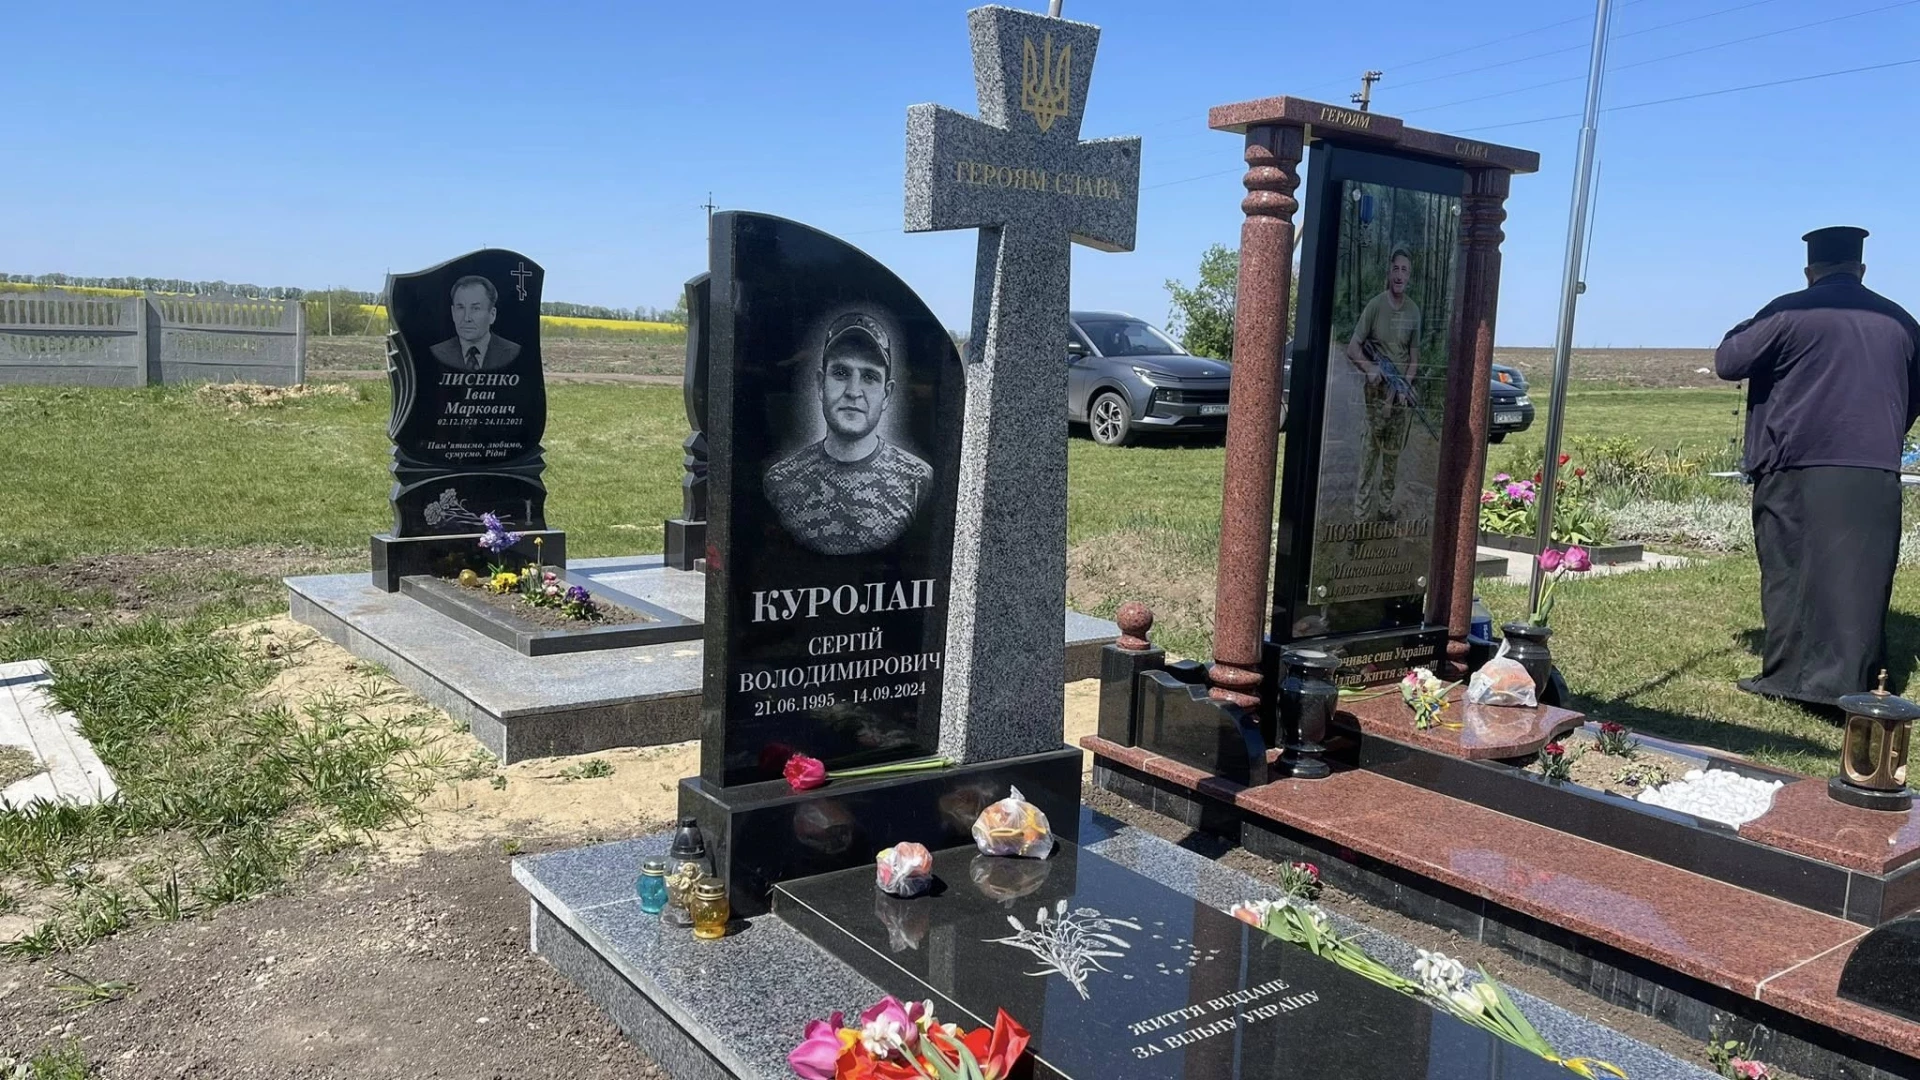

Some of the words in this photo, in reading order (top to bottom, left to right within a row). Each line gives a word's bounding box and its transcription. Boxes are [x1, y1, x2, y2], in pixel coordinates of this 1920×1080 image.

[1320, 107, 1371, 129] ГЕРОЯМ
[1455, 141, 1489, 159] СЛАВА
[956, 160, 1047, 192] ГЕРОЯМ
[1055, 172, 1121, 200] СЛАВА
[438, 372, 520, 386] ЛИСЕНКО
[465, 387, 496, 400] Іван
[437, 418, 478, 426] 02.12.1928
[444, 401, 516, 417] Маркович
[485, 449, 507, 458] Рідні
[1321, 514, 1429, 543] ЛОЗІНСЬКИЙ
[1351, 543, 1399, 560] Микола
[751, 578, 937, 623] КУРОЛАП
[808, 626, 883, 656] СЕРГІЙ
[1374, 651, 1393, 662] син
[1394, 644, 1435, 661] України
[738, 652, 941, 693] ВОЛОДИМИРОВИЧ
[1334, 674, 1362, 686] іддав
[1363, 668, 1396, 683] життя
[754, 692, 836, 717] 21.06.1995
[853, 681, 926, 704] 14.09.2024
[1127, 1006, 1206, 1036] ЖИТТЯ
[1206, 978, 1291, 1012] ВІДДАНЕ
[1131, 1042, 1164, 1060] ЗА
[1163, 1016, 1239, 1051] ВІЛЬНУ
[1240, 990, 1321, 1024] УКРАЇНУ
